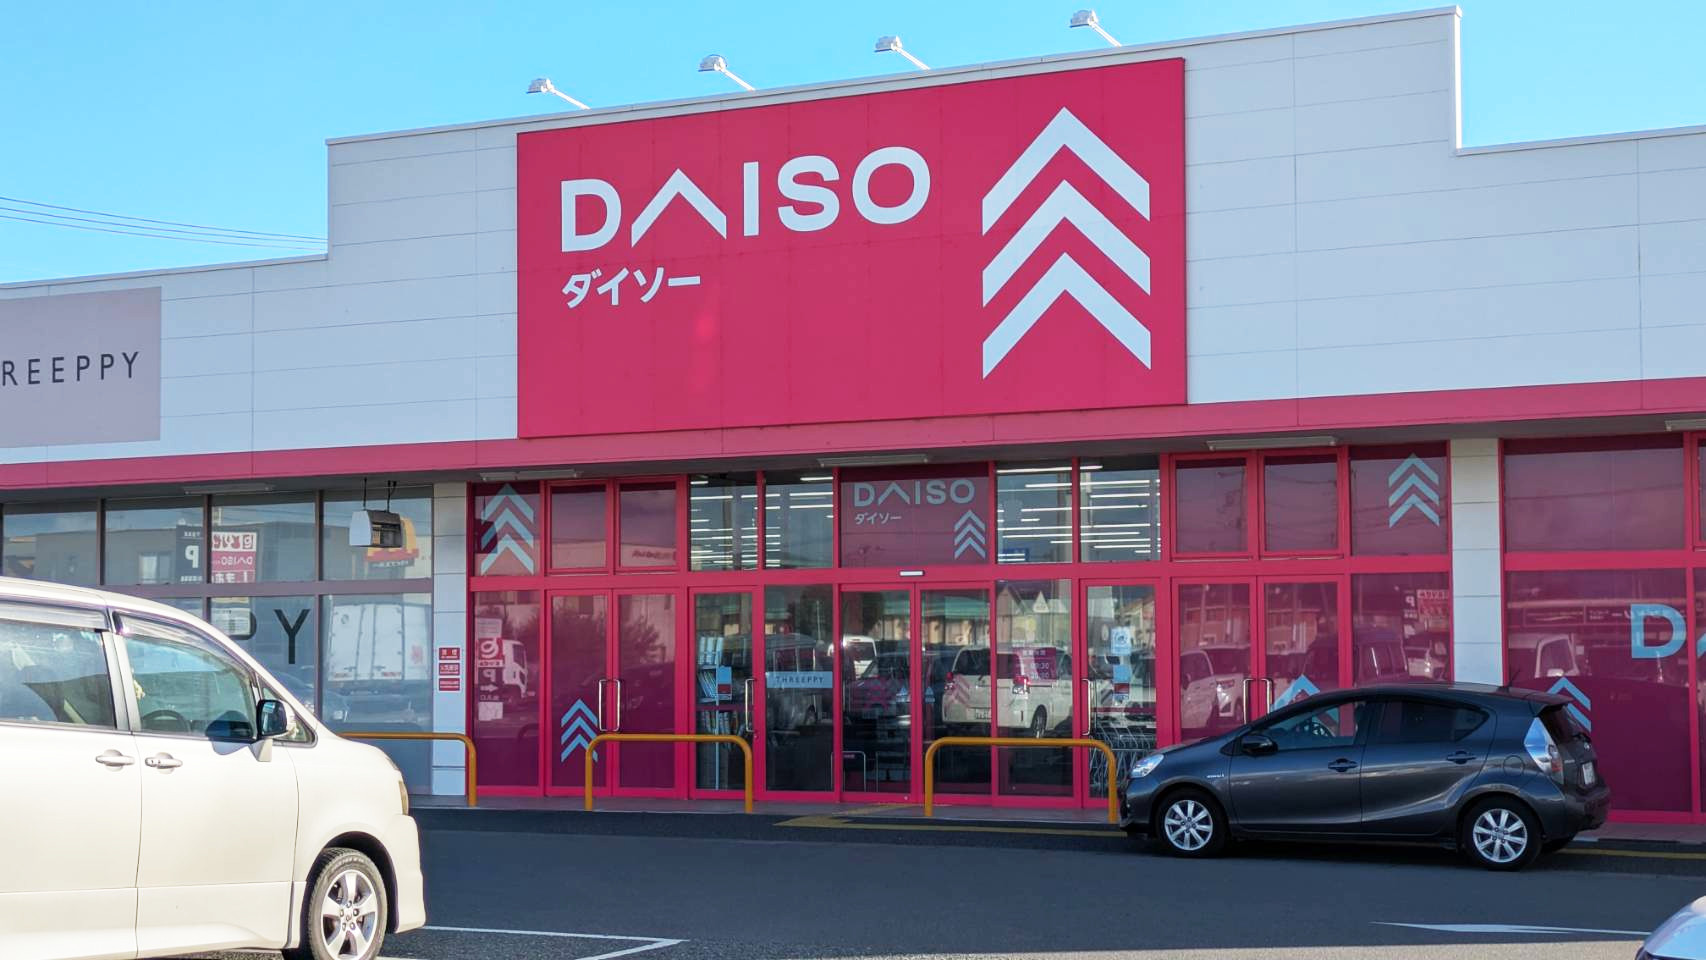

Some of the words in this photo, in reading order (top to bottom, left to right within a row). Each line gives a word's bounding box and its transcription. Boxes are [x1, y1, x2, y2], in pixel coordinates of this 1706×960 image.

[561, 146, 930, 252] DAISO
[562, 268, 700, 308] ダイソー
[2, 351, 138, 386] REEPPY
[854, 479, 975, 506] DAISO
[855, 512, 901, 524] ダイソー
